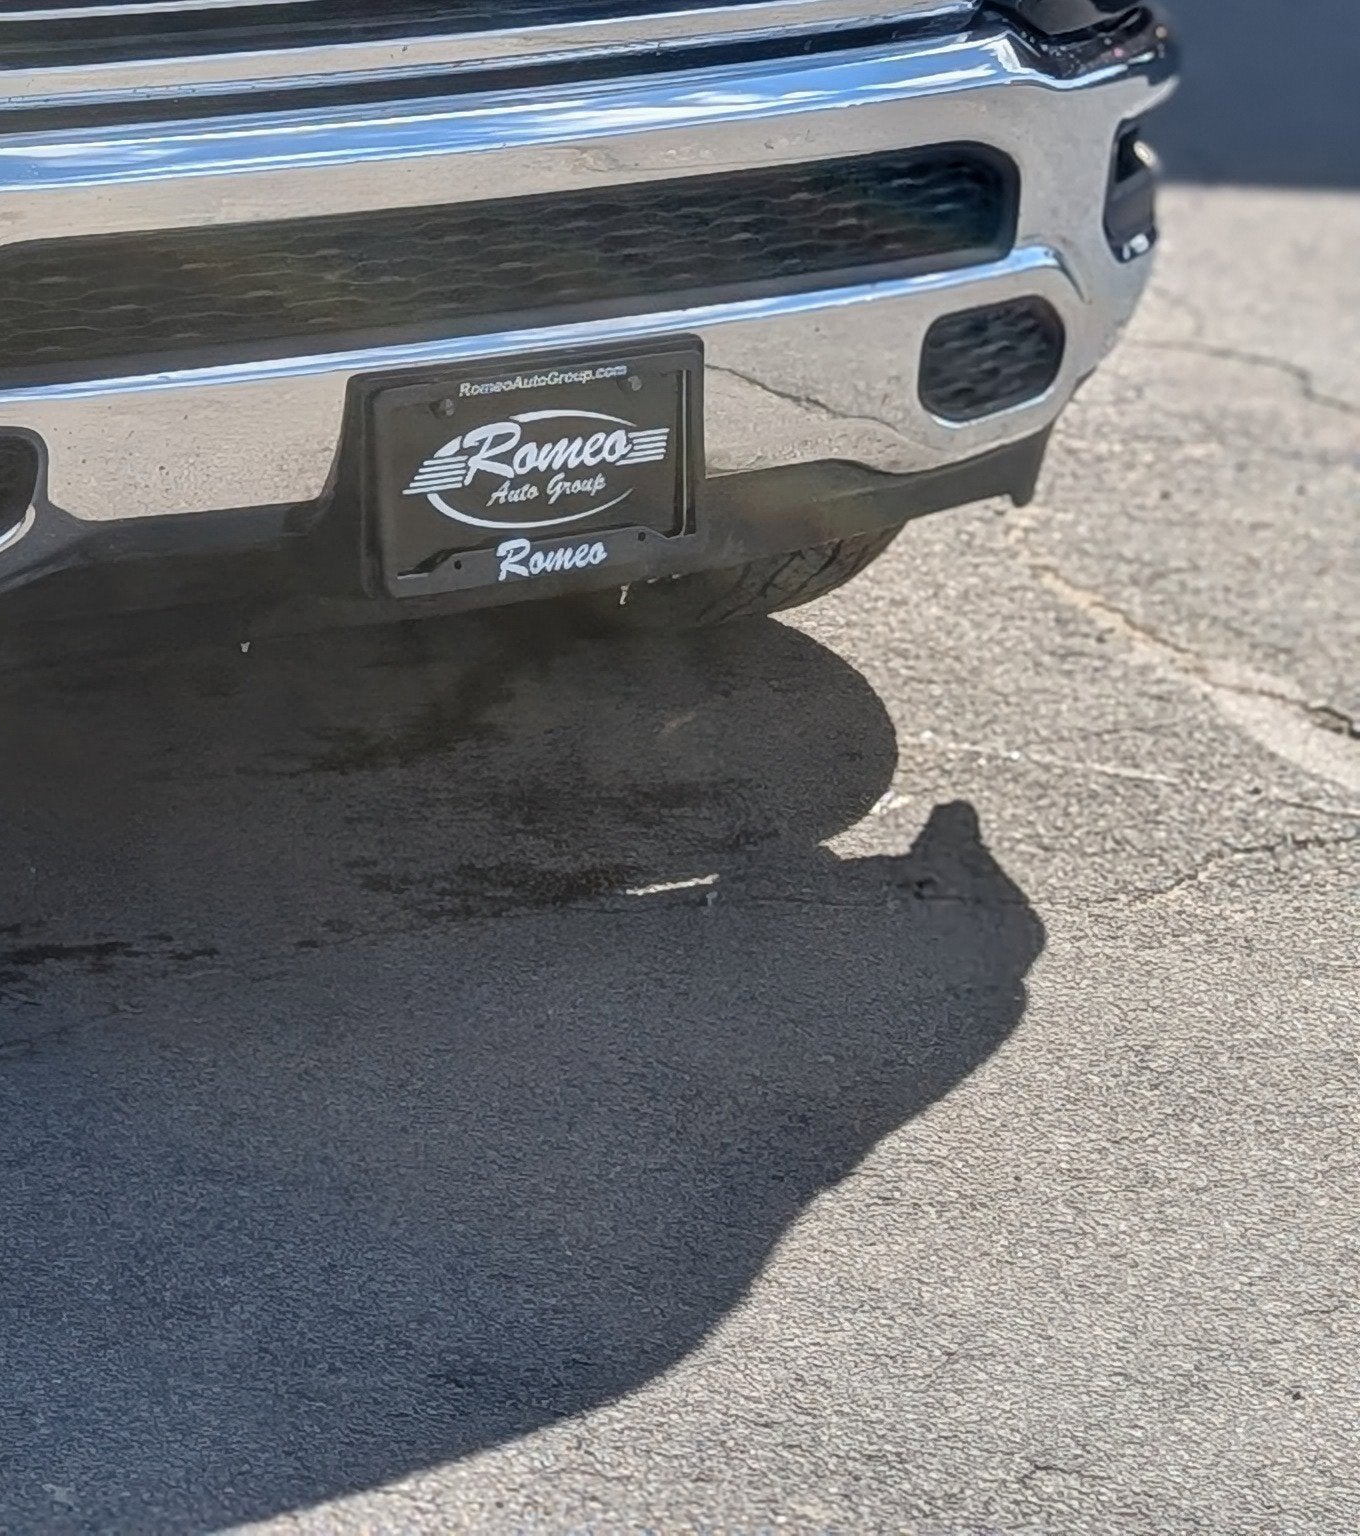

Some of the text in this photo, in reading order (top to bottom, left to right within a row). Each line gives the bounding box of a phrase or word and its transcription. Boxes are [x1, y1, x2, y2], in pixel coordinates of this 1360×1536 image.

[458, 365, 628, 397] RomeoAutoGroup.com
[462, 421, 632, 486] Romeo
[486, 472, 607, 507] Auto Group
[496, 538, 608, 581] Romeo
